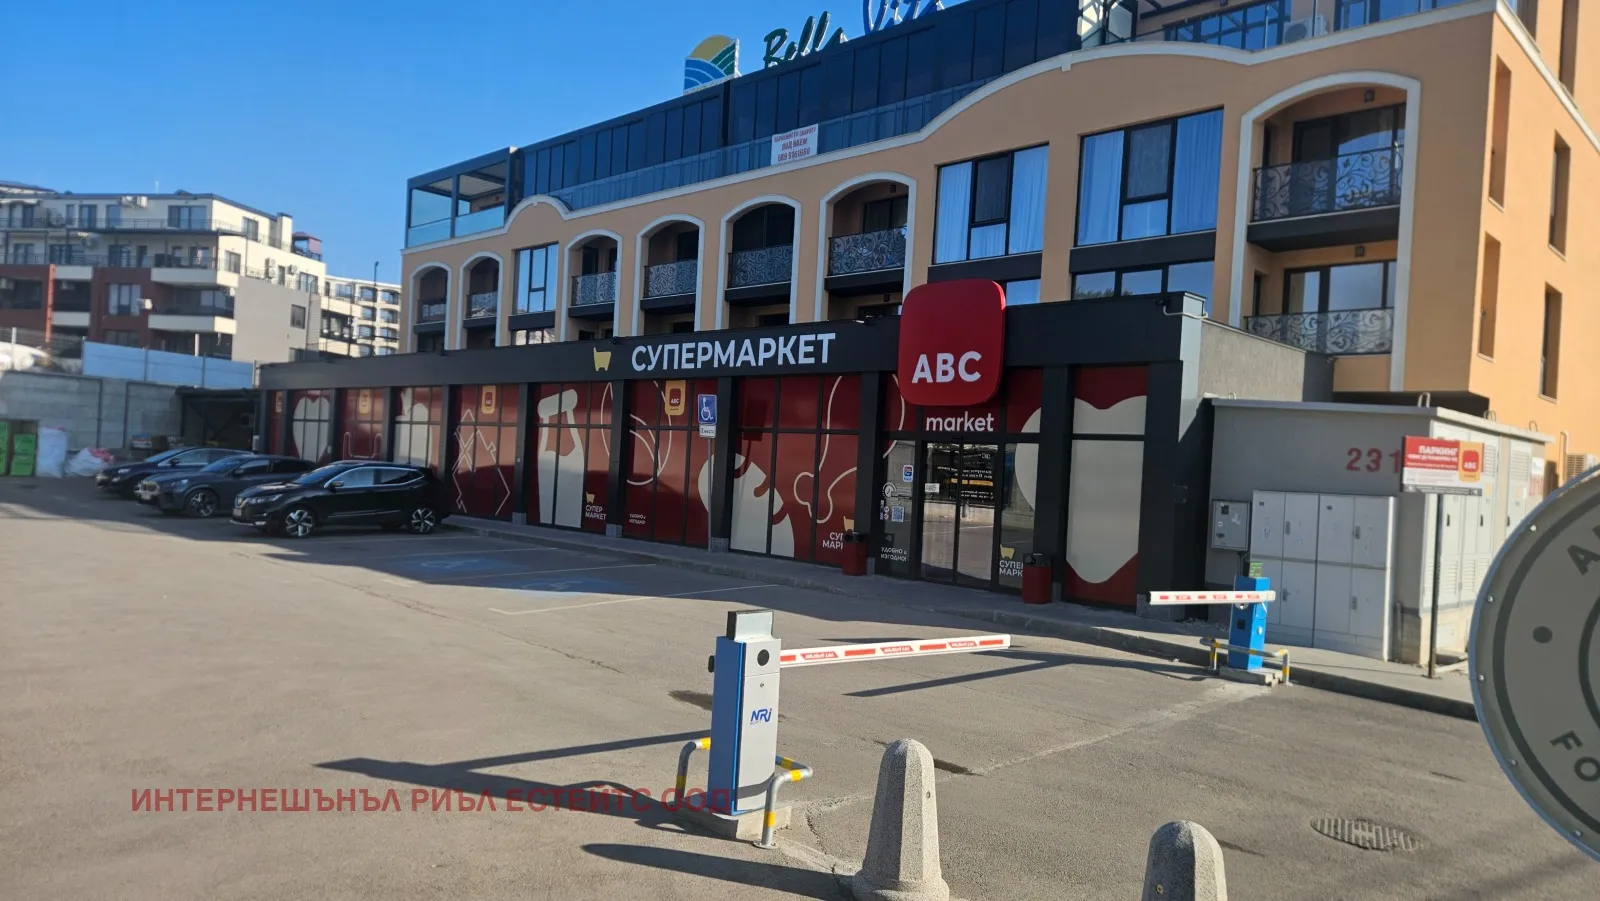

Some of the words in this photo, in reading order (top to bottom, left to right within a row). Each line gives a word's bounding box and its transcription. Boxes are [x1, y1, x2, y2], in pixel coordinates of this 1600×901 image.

[631, 333, 836, 372] СУПЕРМАРКЕТ
[911, 351, 982, 384] ABC
[925, 411, 994, 432] market
[1418, 445, 1458, 455] ПАРКИНГ
[1345, 447, 1401, 473] 231
[586, 505, 603, 513] СУПЕР
[586, 512, 606, 520] МАРКЕТ
[822, 539, 844, 550] МАР
[999, 567, 1023, 577] МАРК
[1550, 730, 1600, 782] FO
